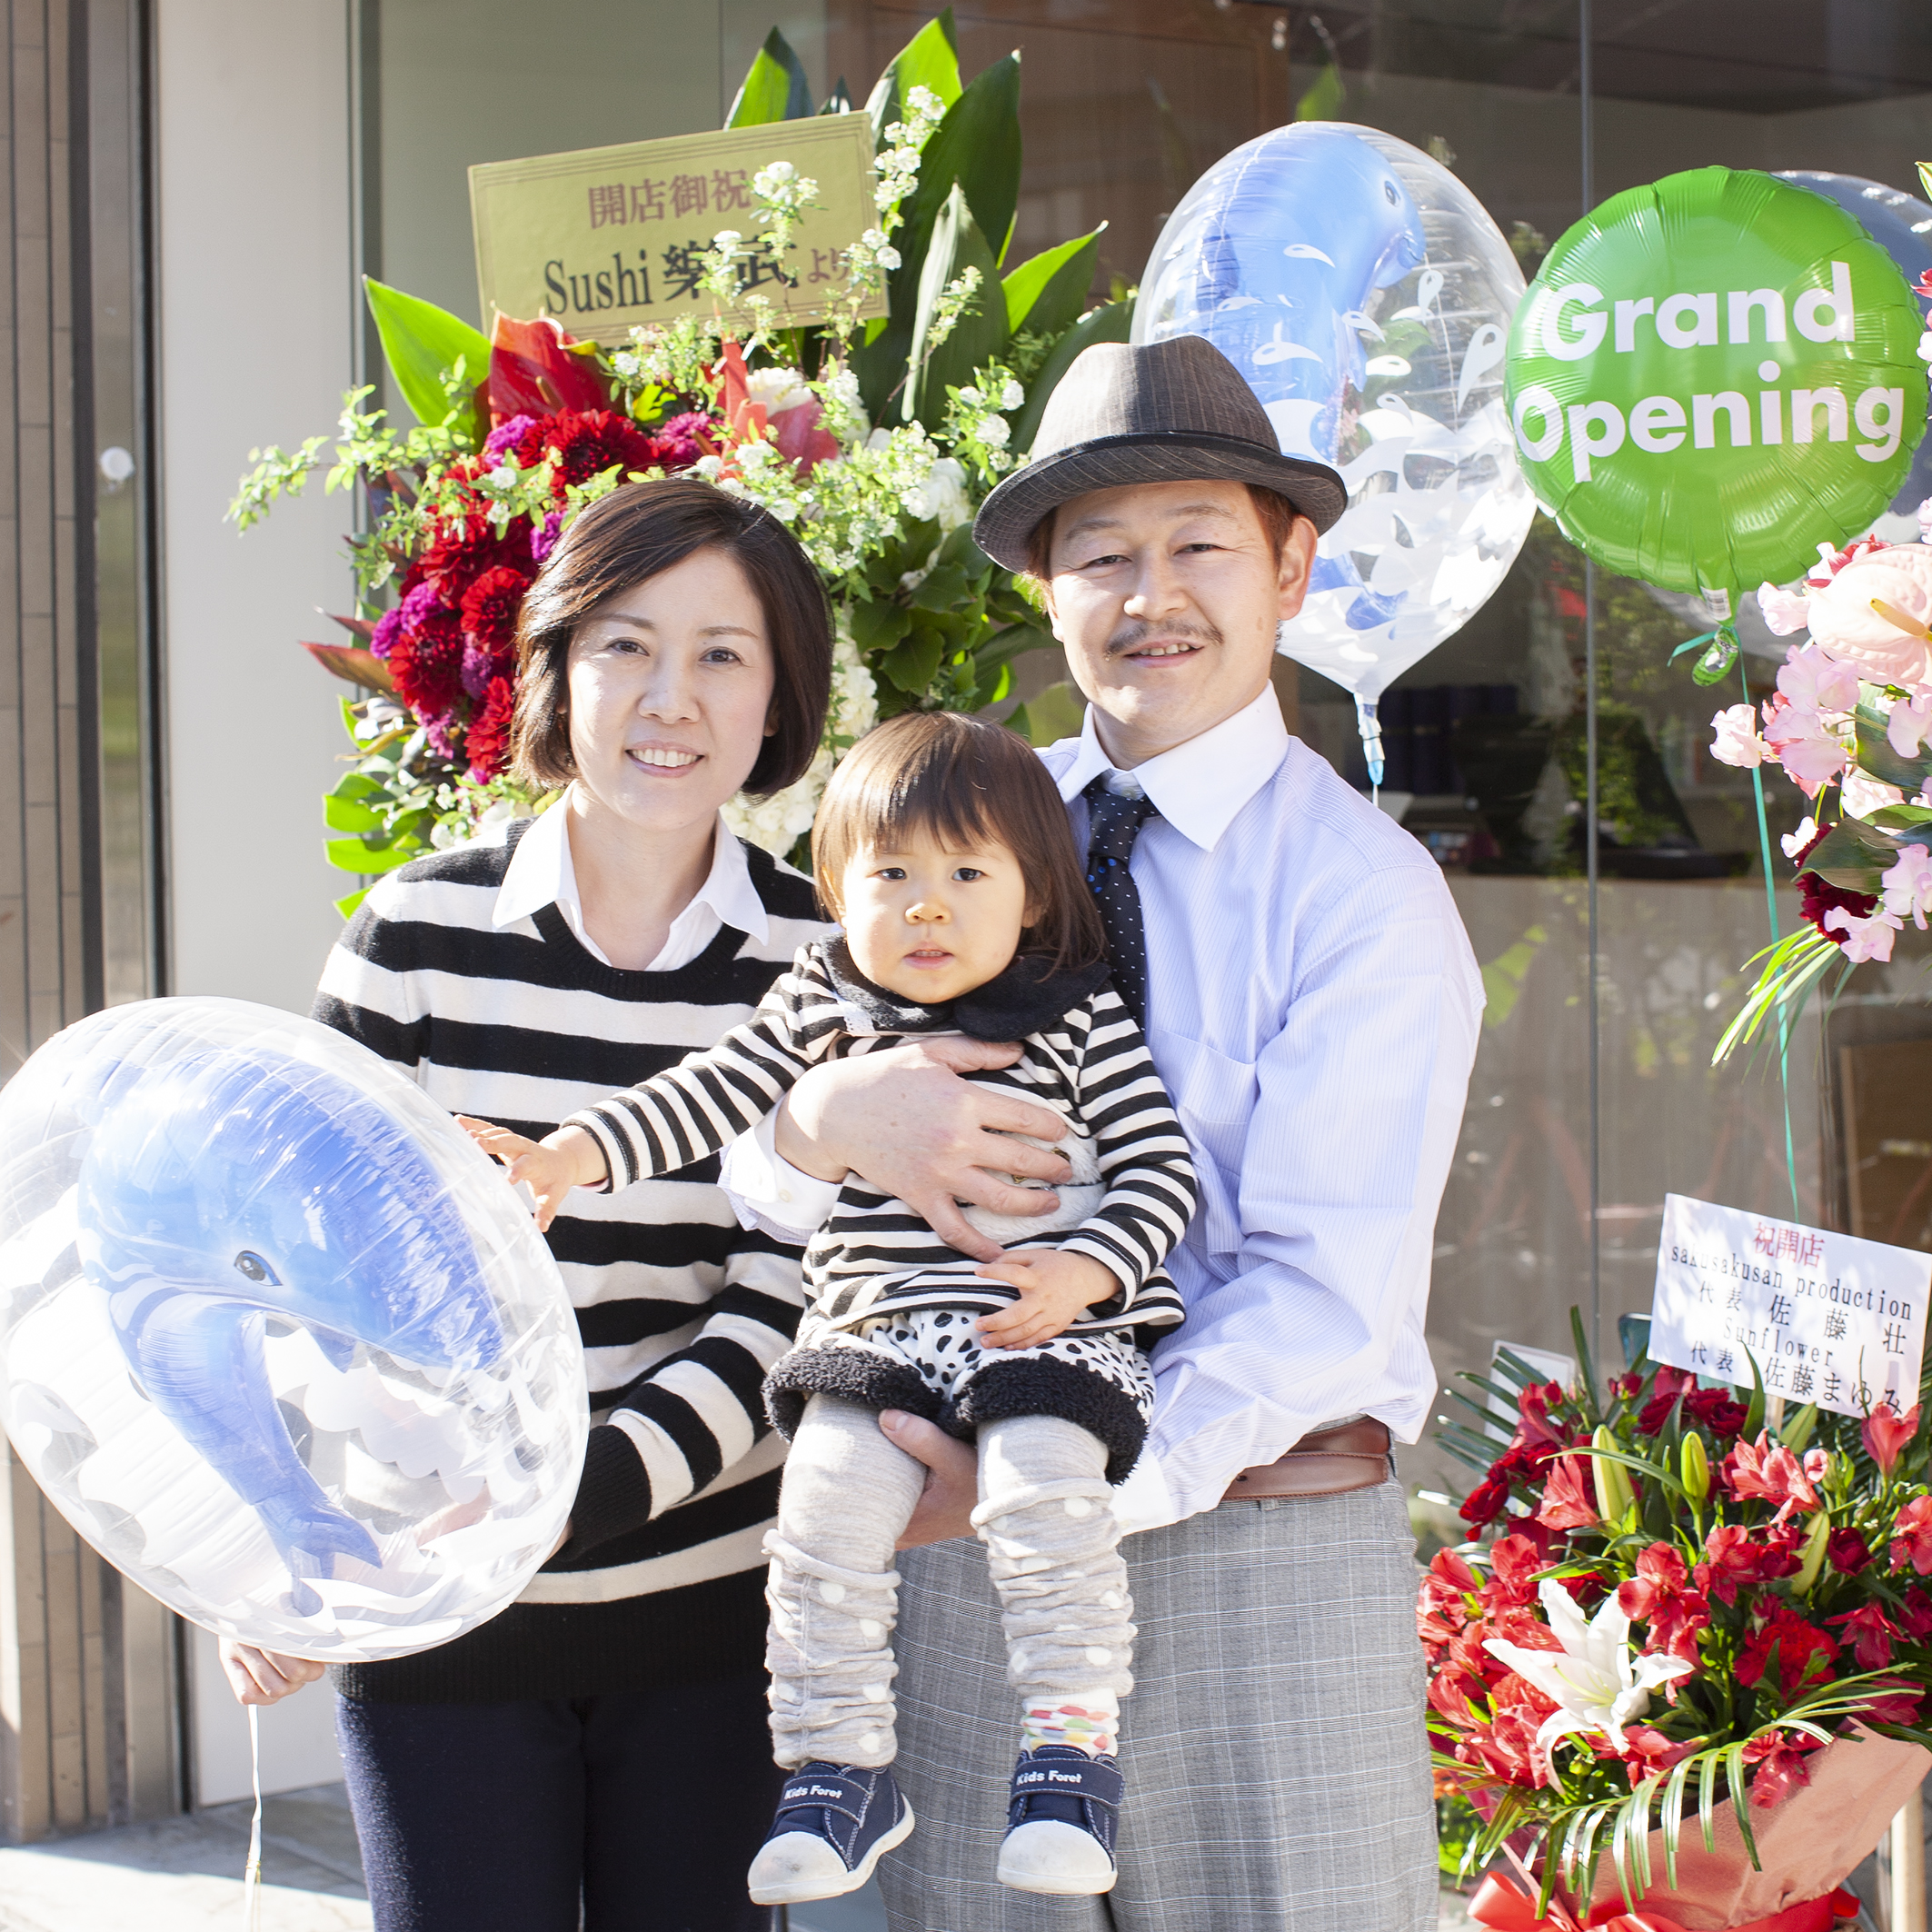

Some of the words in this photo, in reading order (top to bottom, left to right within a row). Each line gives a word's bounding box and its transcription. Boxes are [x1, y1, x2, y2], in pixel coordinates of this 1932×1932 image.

[588, 169, 752, 229] 開店御祝
[544, 248, 653, 314] Sushi
[1541, 261, 1855, 362] Grand
[1513, 360, 1905, 483] Opening
[1753, 1222, 1826, 1268] 祝開店
[1671, 1244, 1783, 1289] sakusakusan
[1795, 1279, 1912, 1320] production
[1724, 1317, 1834, 1367] Sunflower
[783, 1787, 809, 1800] Kids
[810, 1785, 842, 1799] Foret
[1016, 1771, 1045, 1786] Kids
[1048, 1769, 1082, 1784] Foret
